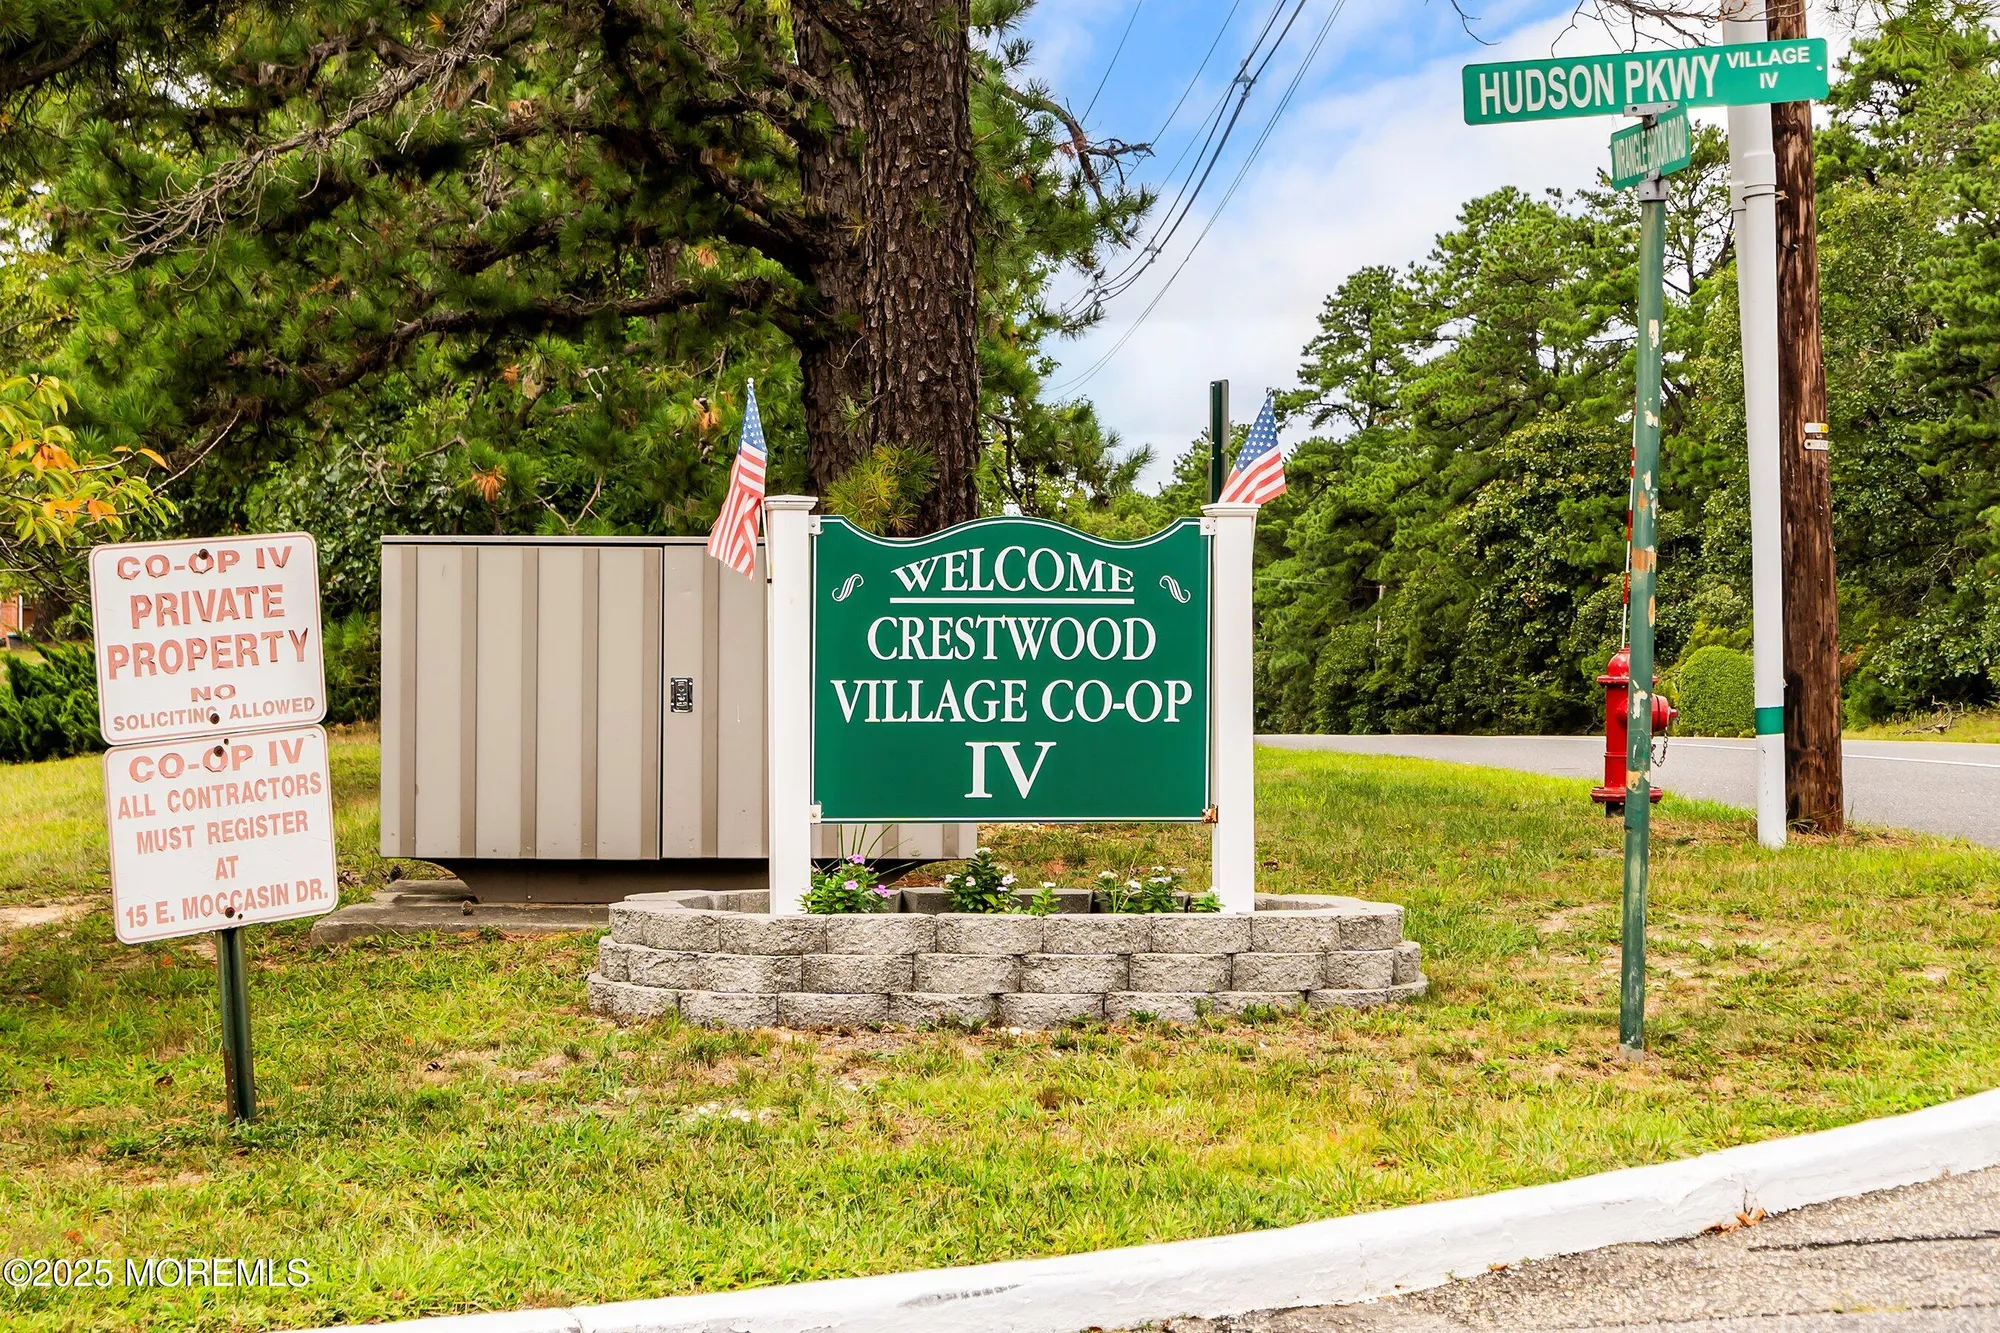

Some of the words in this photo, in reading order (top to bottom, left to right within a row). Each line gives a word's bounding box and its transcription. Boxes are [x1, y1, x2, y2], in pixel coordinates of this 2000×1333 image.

[1726, 46, 1810, 69] VILLAGE
[1479, 63, 1615, 116] HUDSON
[1625, 54, 1720, 103] PKWY
[1759, 72, 1779, 89] IV
[117, 549, 241, 580] CO-OP
[255, 546, 293, 569] IV
[890, 545, 1135, 593] WELCOME
[130, 584, 285, 630] PRIVATE
[107, 627, 309, 680] PROPERTY
[867, 614, 1157, 661] CRESTWOOD
[191, 684, 236, 702] NO
[229, 696, 316, 720] ALLOWED
[830, 679, 1028, 724] VILLAGE
[1041, 679, 1193, 724] CO-OP
[129, 744, 254, 783] CO-OP
[268, 738, 304, 767] IV
[964, 741, 1057, 800] IV
[117, 793, 156, 820] ALL
[167, 771, 322, 814] CONTRACTORS
[136, 825, 196, 855] MUST
[207, 810, 309, 845] REGISTER
[215, 855, 239, 881] AT
[126, 904, 148, 928] 15
[155, 900, 175, 925] E.
[182, 883, 289, 918] MOCCASIN
[296, 878, 329, 903] DR.
